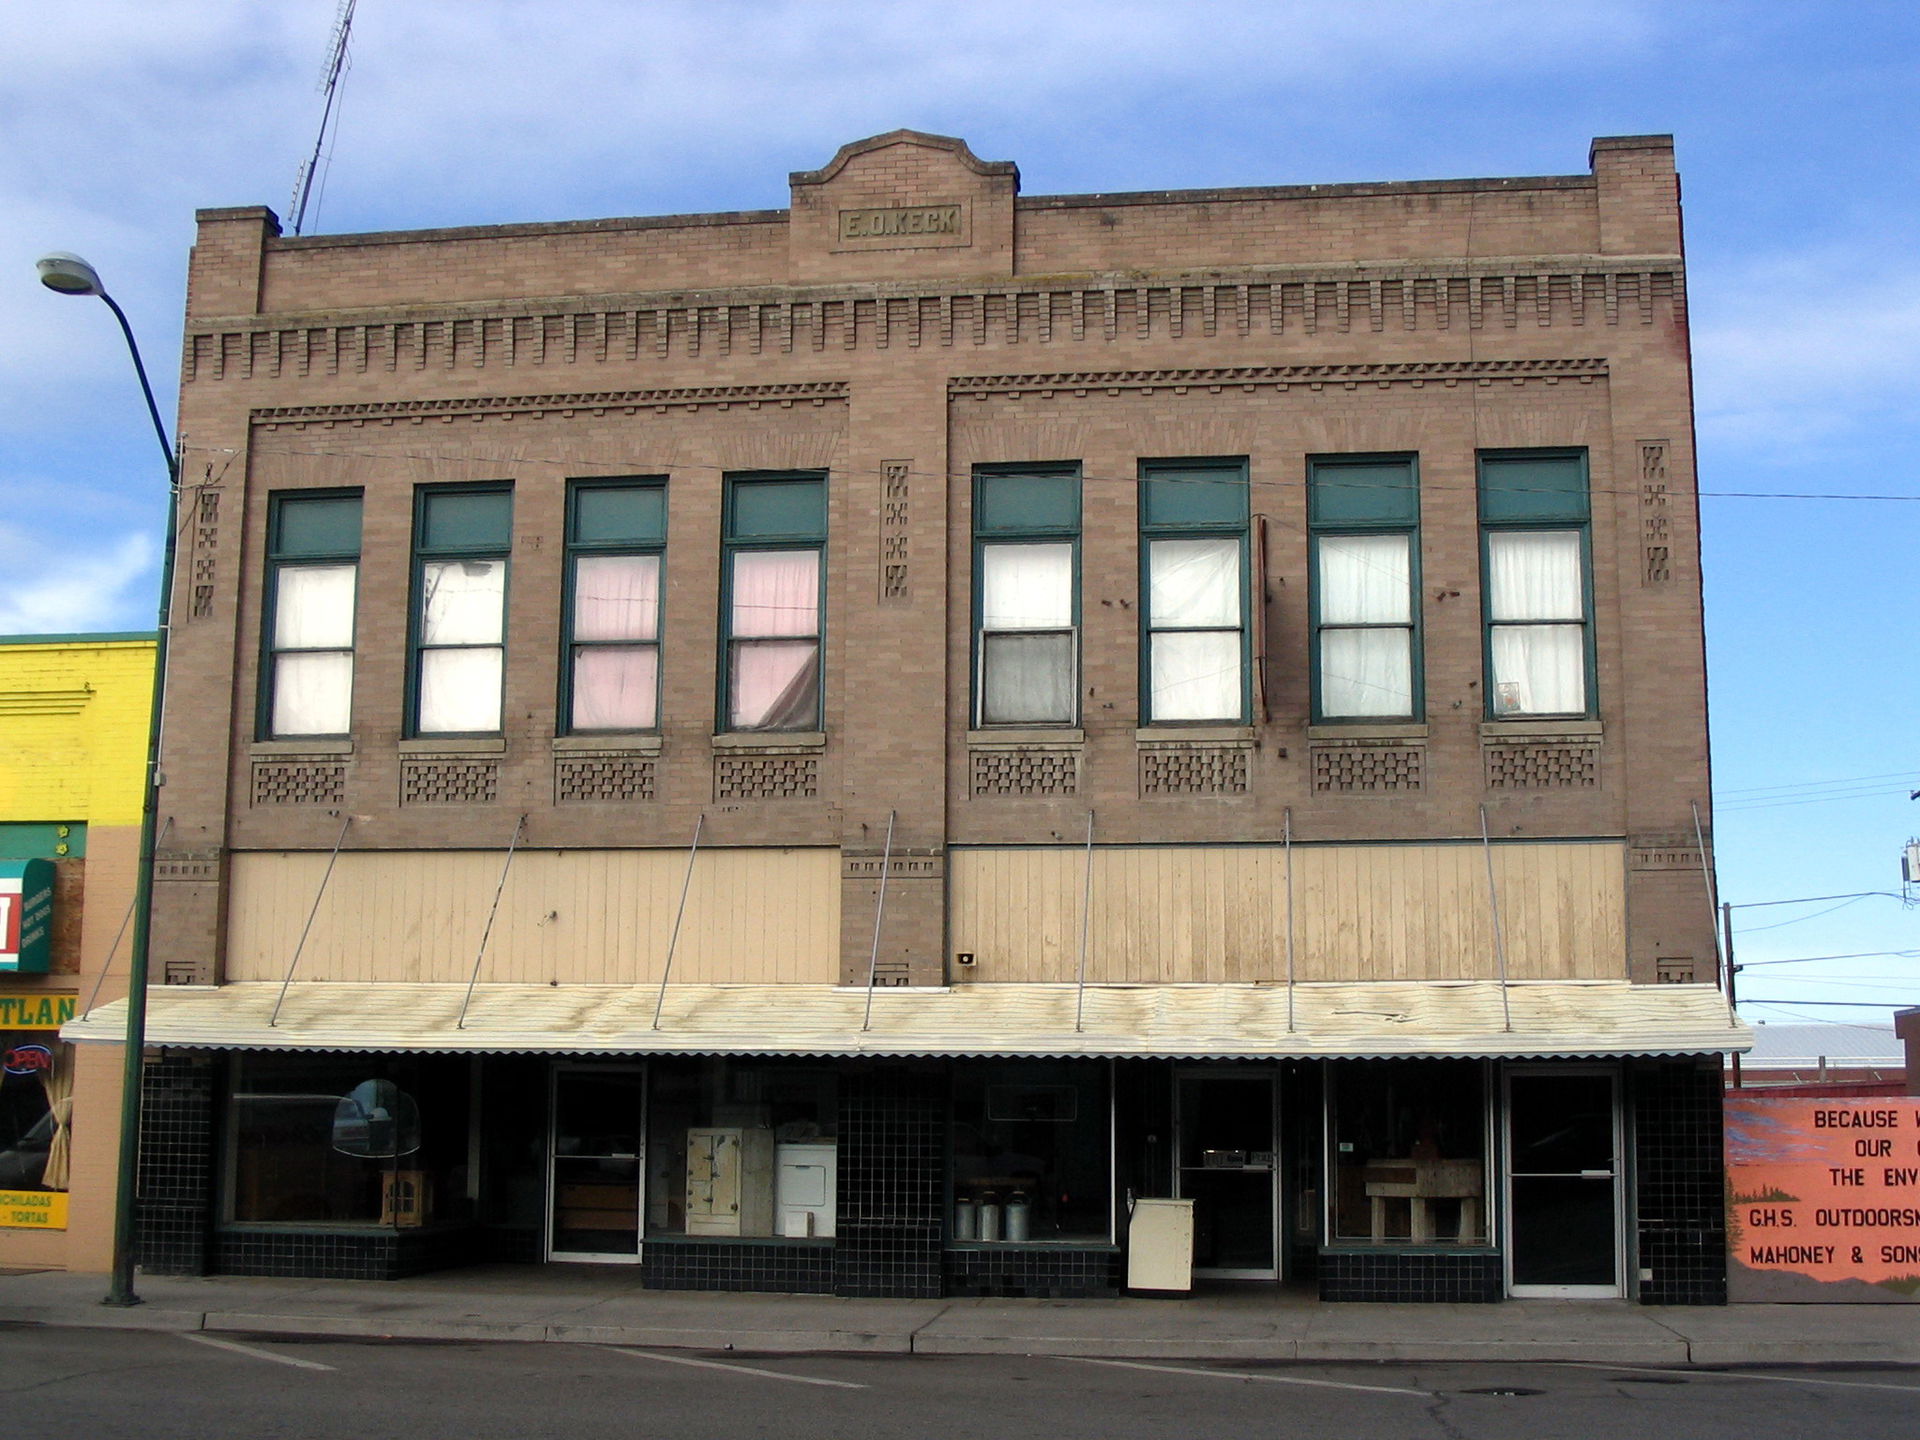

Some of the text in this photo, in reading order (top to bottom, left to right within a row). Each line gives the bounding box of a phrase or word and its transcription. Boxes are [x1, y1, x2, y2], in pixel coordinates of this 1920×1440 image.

[22, 925, 45, 949] DRINKS
[3, 1049, 52, 1069] OPEN
[1814, 1110, 1898, 1128] BECAUSE
[1855, 1139, 1892, 1157] OUR
[1829, 1168, 1919, 1186] THE ENV
[11, 1211, 49, 1224] TORTAS
[1751, 1246, 1920, 1264] MAHONEY & SON
